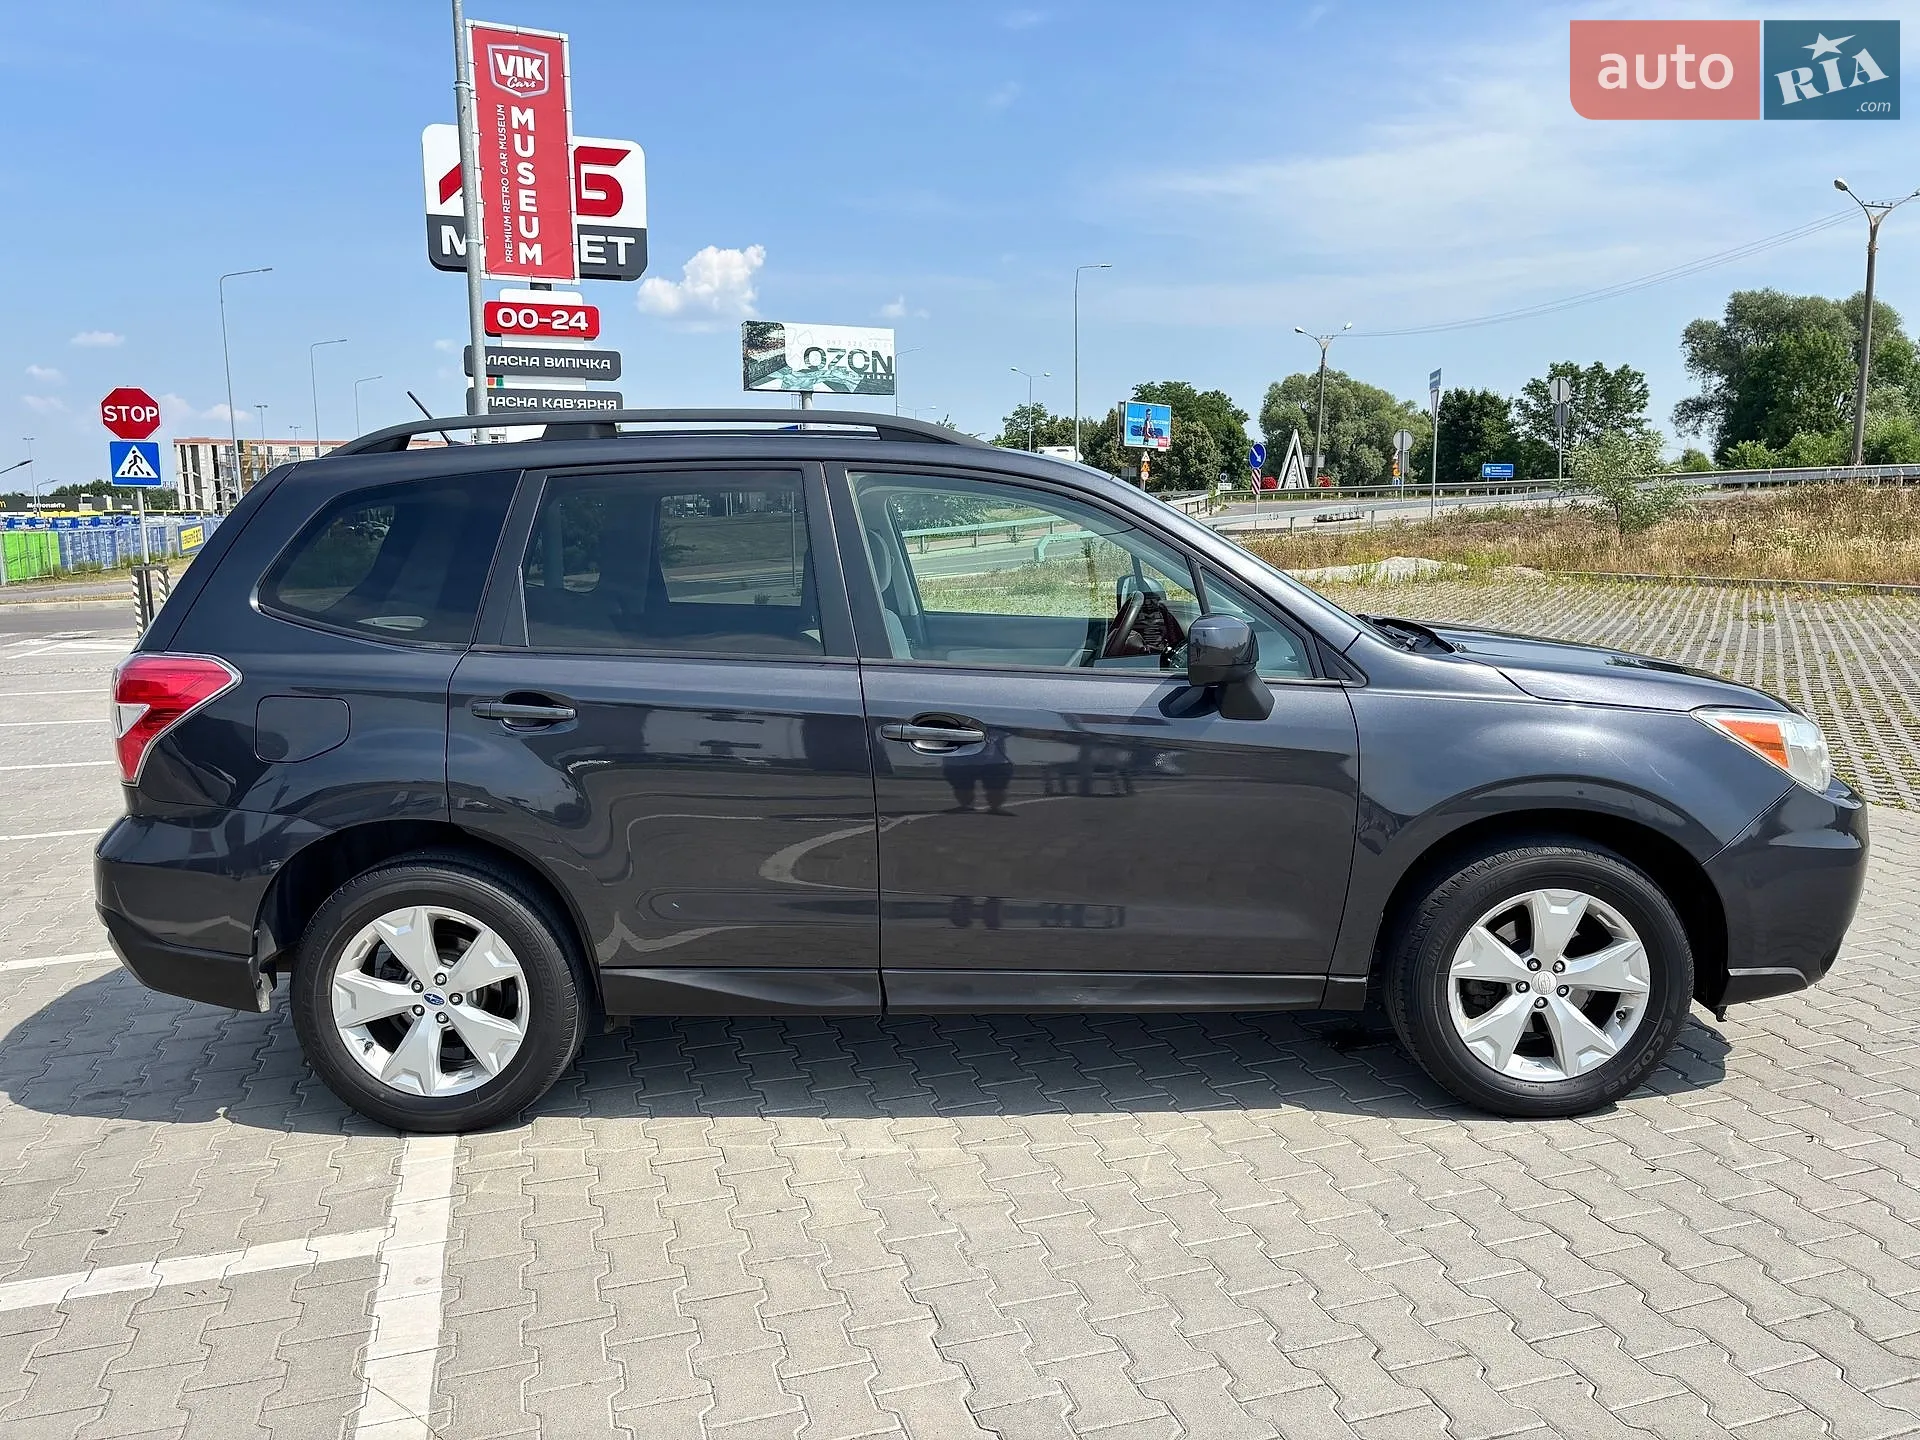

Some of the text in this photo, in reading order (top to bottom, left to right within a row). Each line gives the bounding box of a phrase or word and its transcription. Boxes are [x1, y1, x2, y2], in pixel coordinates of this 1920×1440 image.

[495, 52, 544, 81] VIK
[506, 77, 536, 89] Cars
[496, 104, 514, 263] PREMIUM RETRO CAR MUSEUM
[511, 105, 543, 266] MUSEUM
[496, 307, 589, 331] 00-24
[485, 355, 611, 370] ЛАСНА ВИПІЧКА
[803, 346, 893, 375] OZON
[103, 405, 158, 422] STOP
[486, 396, 617, 410] ЛАСНА КАВ'ЯРНЯ
